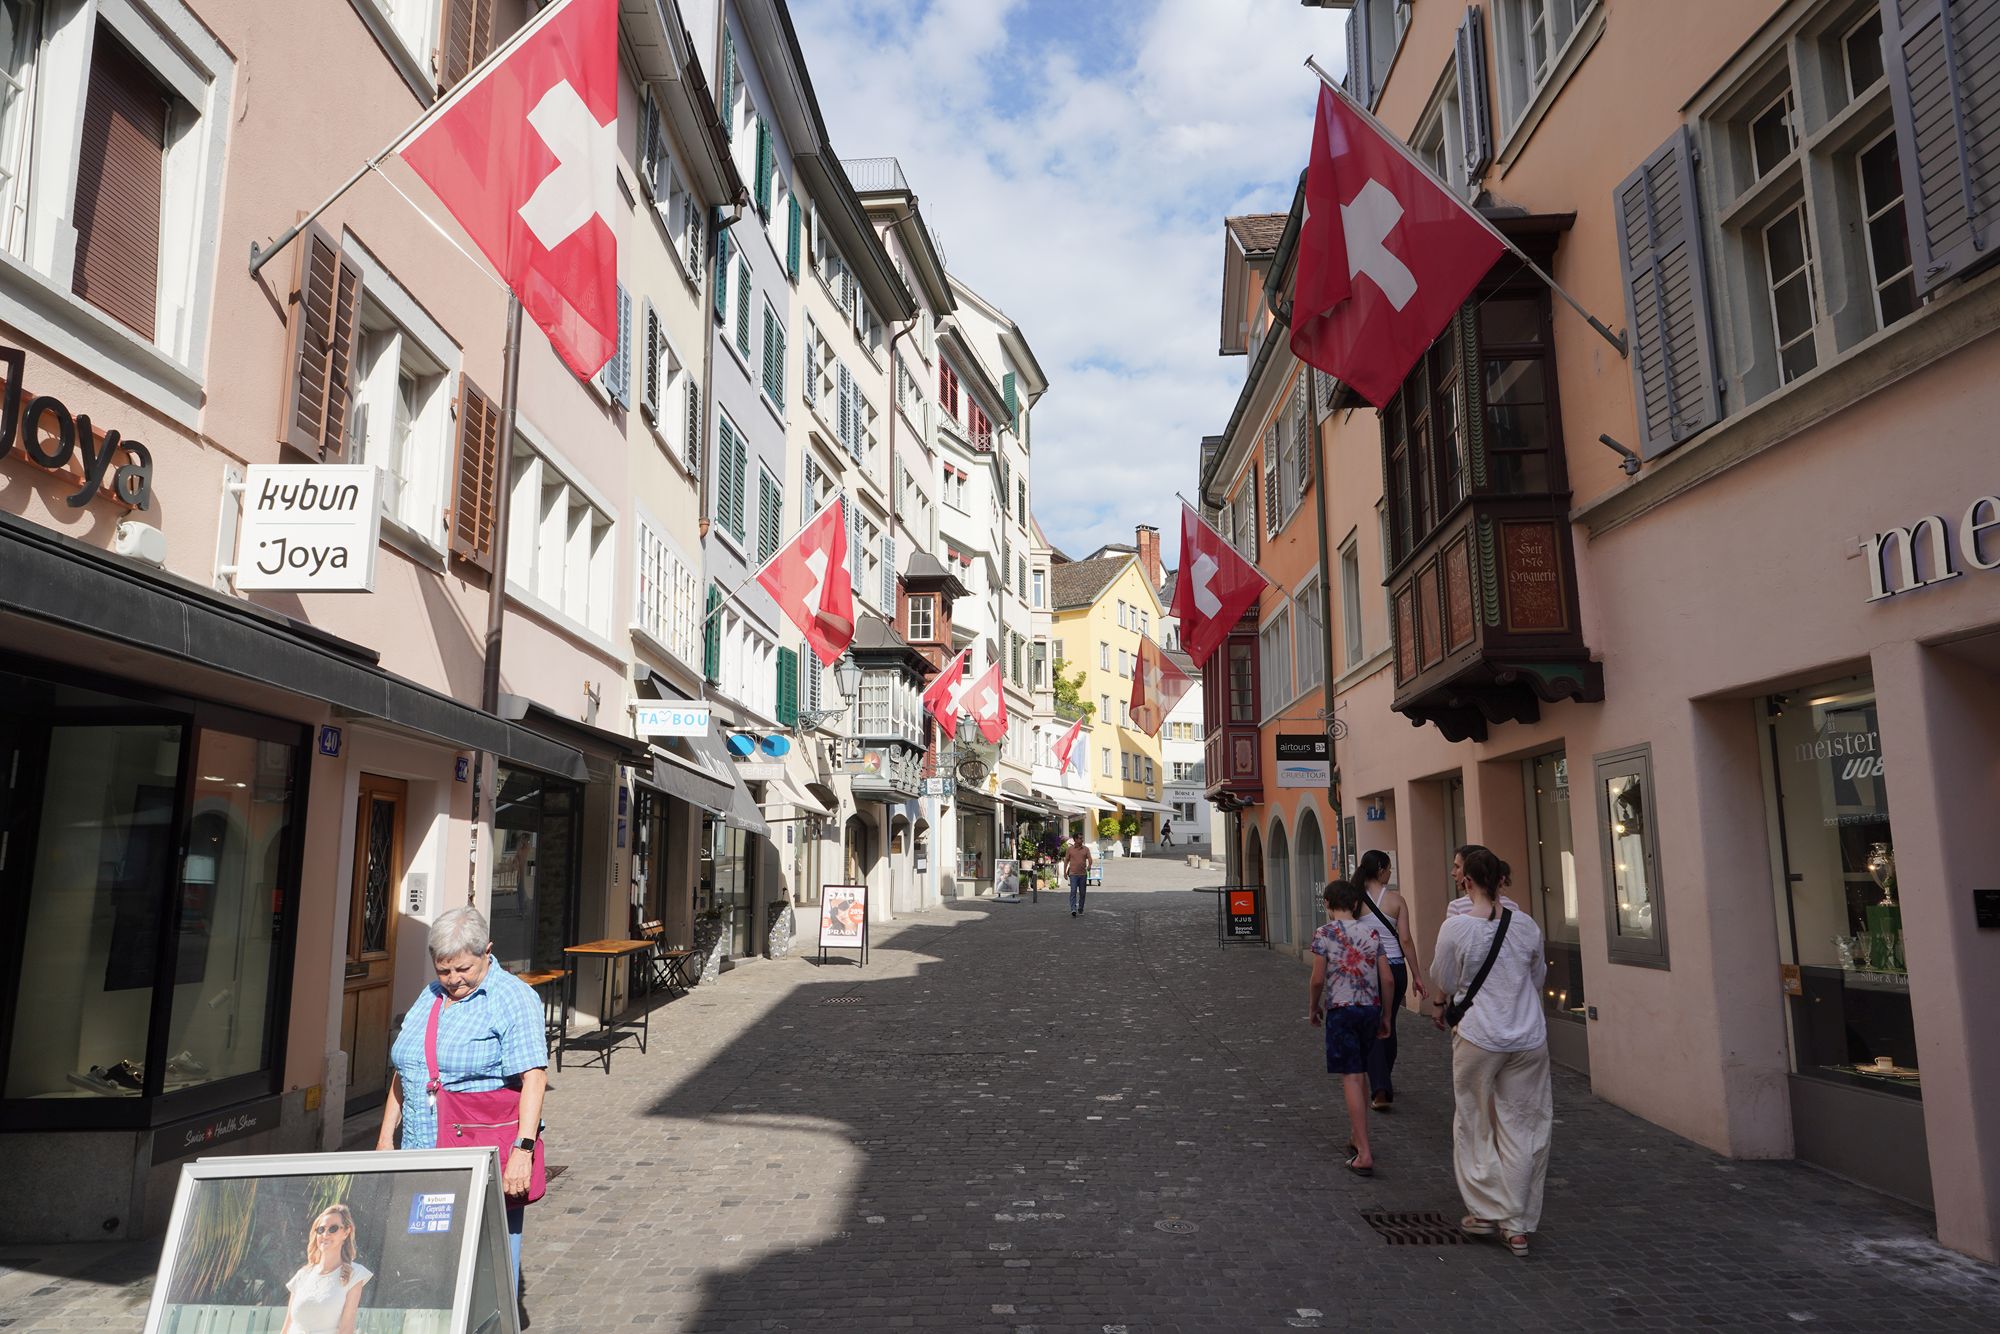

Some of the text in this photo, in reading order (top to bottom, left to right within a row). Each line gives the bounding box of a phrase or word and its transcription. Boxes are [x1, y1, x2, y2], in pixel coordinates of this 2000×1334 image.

[257, 478, 359, 511] kybun
[257, 537, 348, 577] Joya
[324, 731, 338, 752] 40
[1280, 742, 1311, 752] airtours
[1795, 731, 1877, 762] meister
[184, 1114, 257, 1147] Swiss Health Shoes
